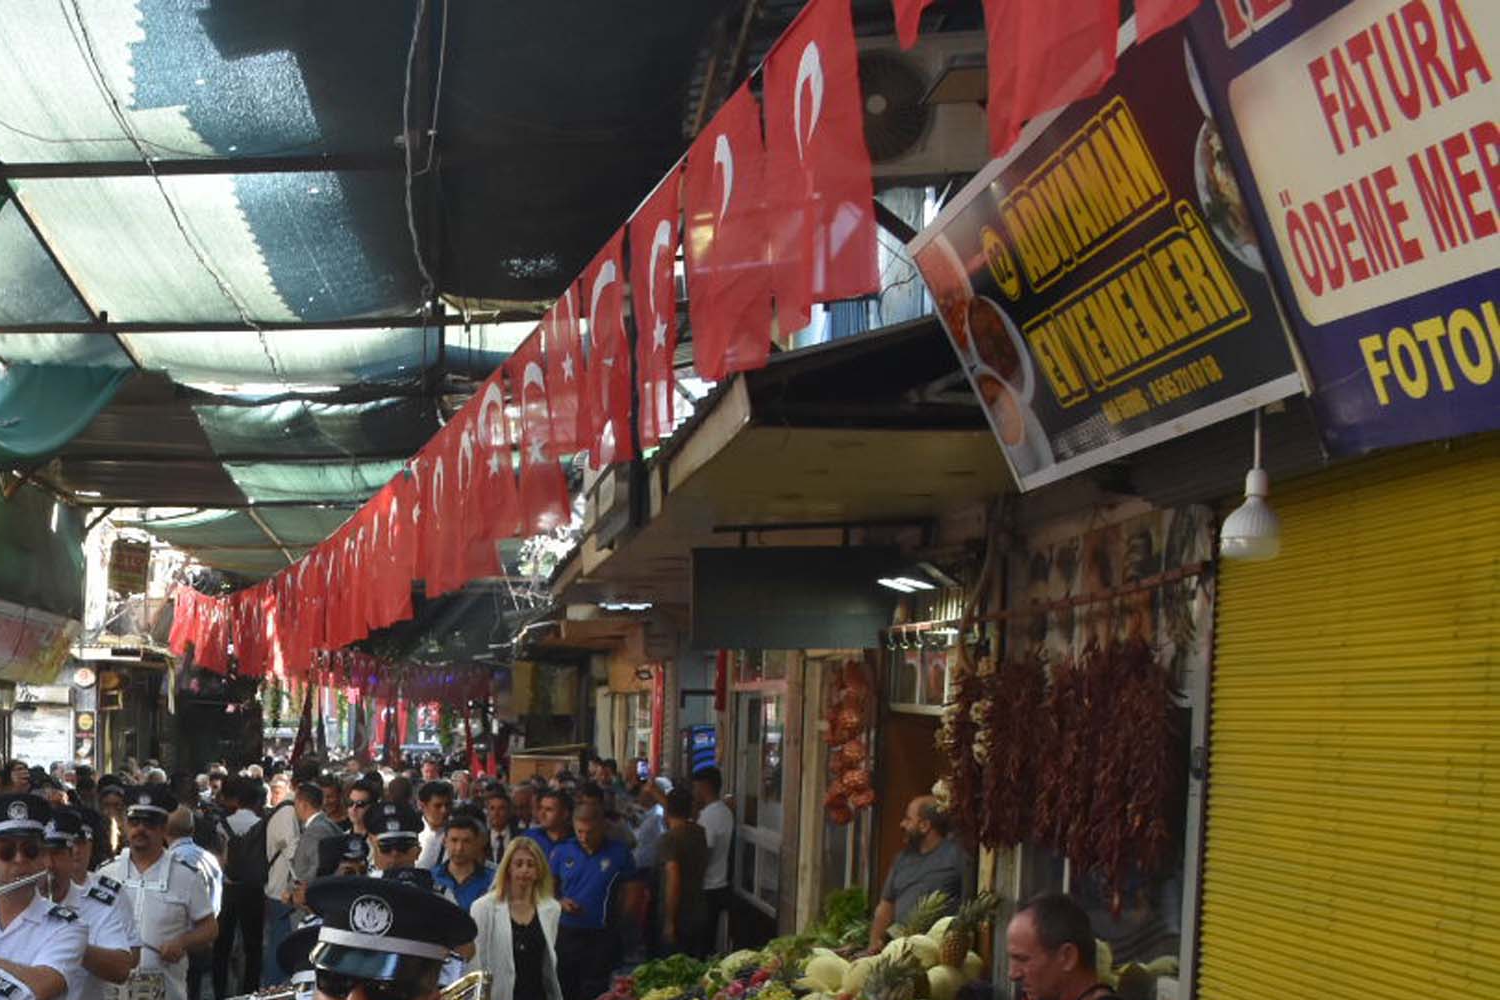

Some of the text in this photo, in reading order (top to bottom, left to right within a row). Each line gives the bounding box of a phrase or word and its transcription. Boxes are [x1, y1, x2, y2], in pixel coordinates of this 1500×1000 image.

[1306, 0, 1493, 156] FATURA
[1004, 110, 1165, 285] ADIYAMAN
[1279, 164, 1425, 298] ÖDEME
[1026, 314, 1089, 400] EV
[1055, 208, 1243, 390] YEMEKLERİ
